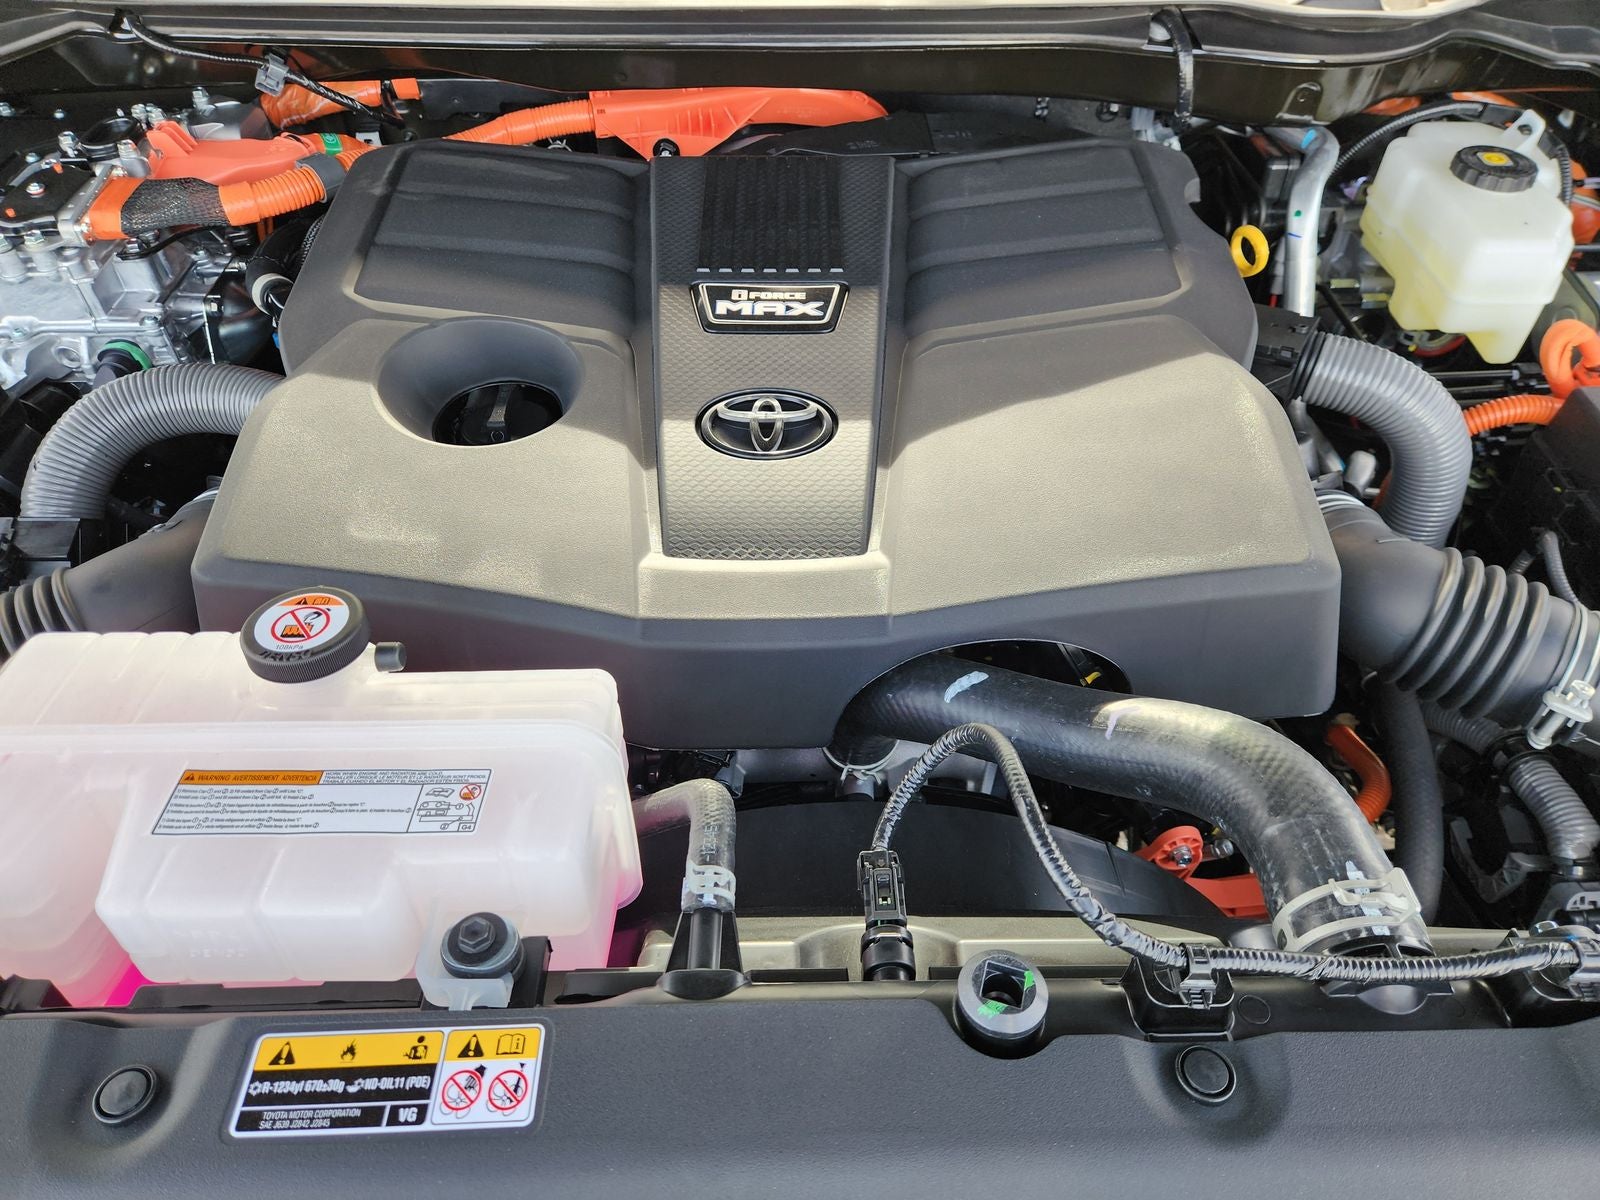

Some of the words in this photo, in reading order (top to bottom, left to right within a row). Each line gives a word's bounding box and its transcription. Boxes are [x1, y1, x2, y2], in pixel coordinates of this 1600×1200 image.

[714, 300, 825, 316] MAX
[262, 1080, 305, 1095] R-1234yf
[364, 1077, 405, 1090] ND-OIL11
[405, 1075, 431, 1091] (POE)
[263, 1111, 288, 1120] TOYOTA
[289, 1110, 313, 1119] MOTOR
[314, 1108, 361, 1118] CORPORATION
[398, 1106, 418, 1123] VG
[259, 1120, 274, 1129] SAE
[273, 1120, 290, 1129] J639
[290, 1119, 310, 1128] J2842
[310, 1118, 331, 1128] J2845
